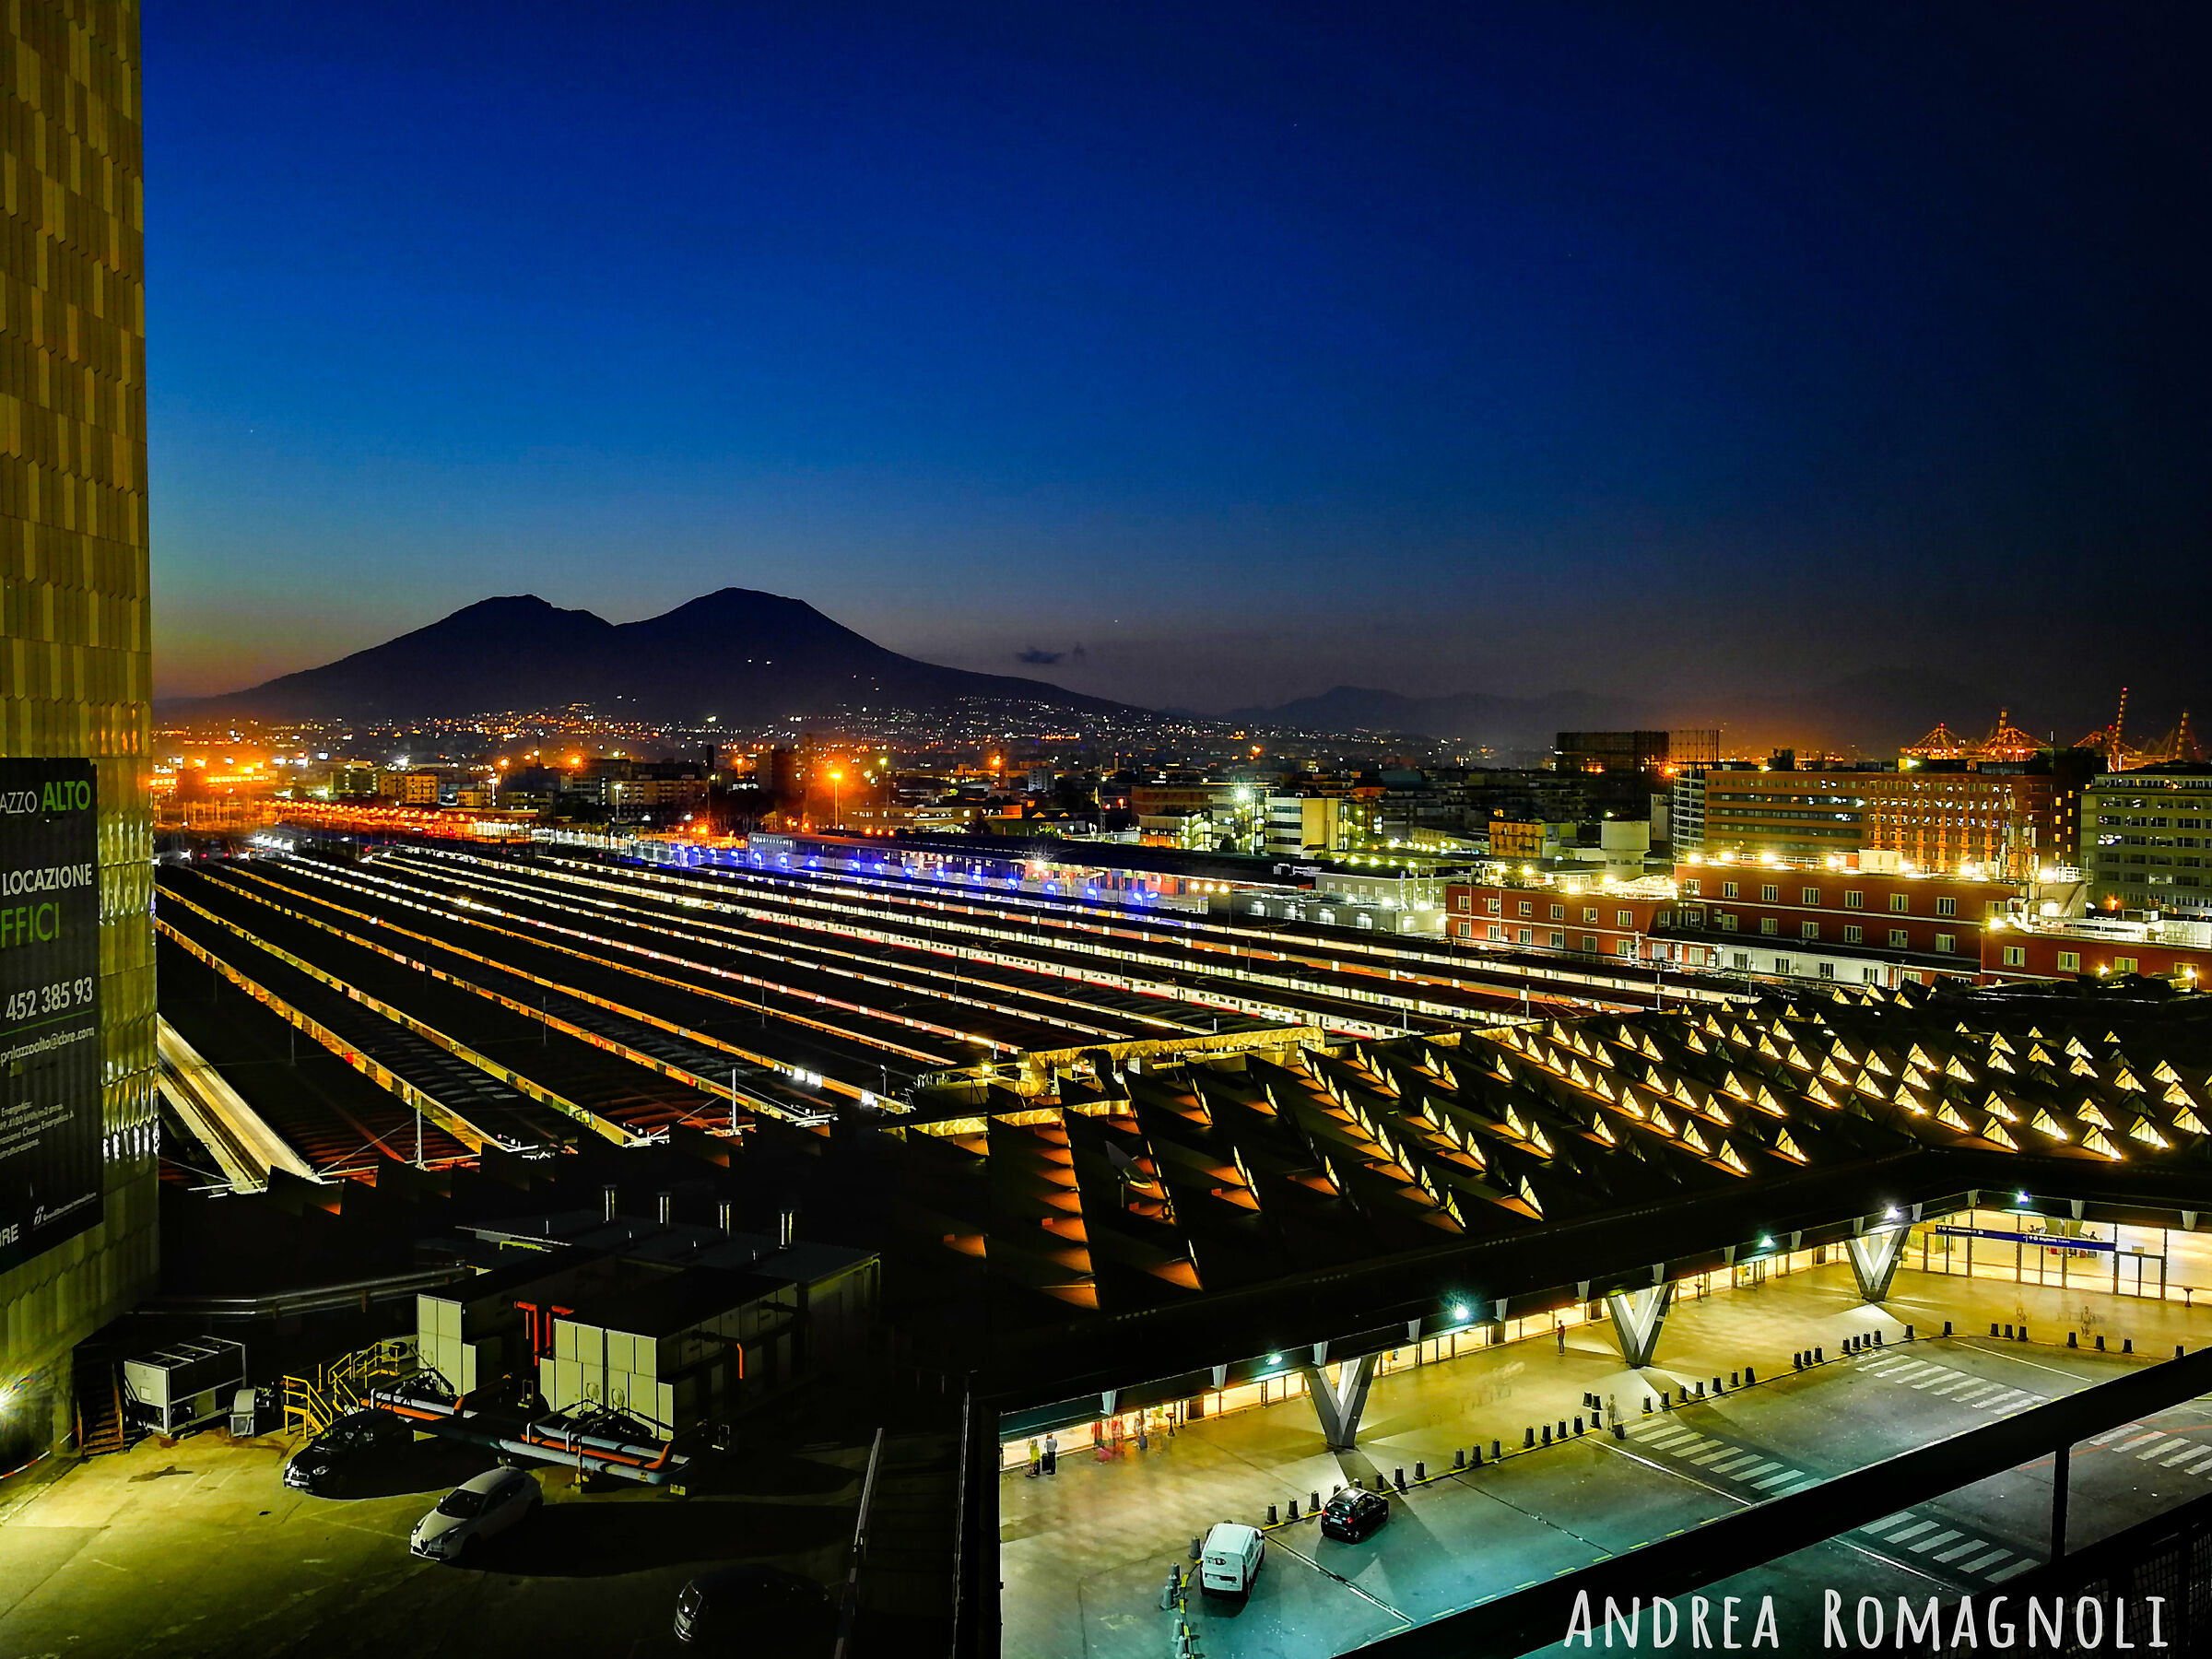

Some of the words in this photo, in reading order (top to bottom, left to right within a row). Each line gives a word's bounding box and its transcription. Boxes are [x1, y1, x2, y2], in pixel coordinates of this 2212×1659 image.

[41, 780, 90, 812] ALTO
[2, 864, 92, 896] LOCAZIONE
[1, 902, 60, 948] FFICI
[6, 990, 37, 1020] 452
[41, 982, 70, 1013] 385
[74, 977, 93, 1005] 93
[0, 1223, 19, 1248] RE
